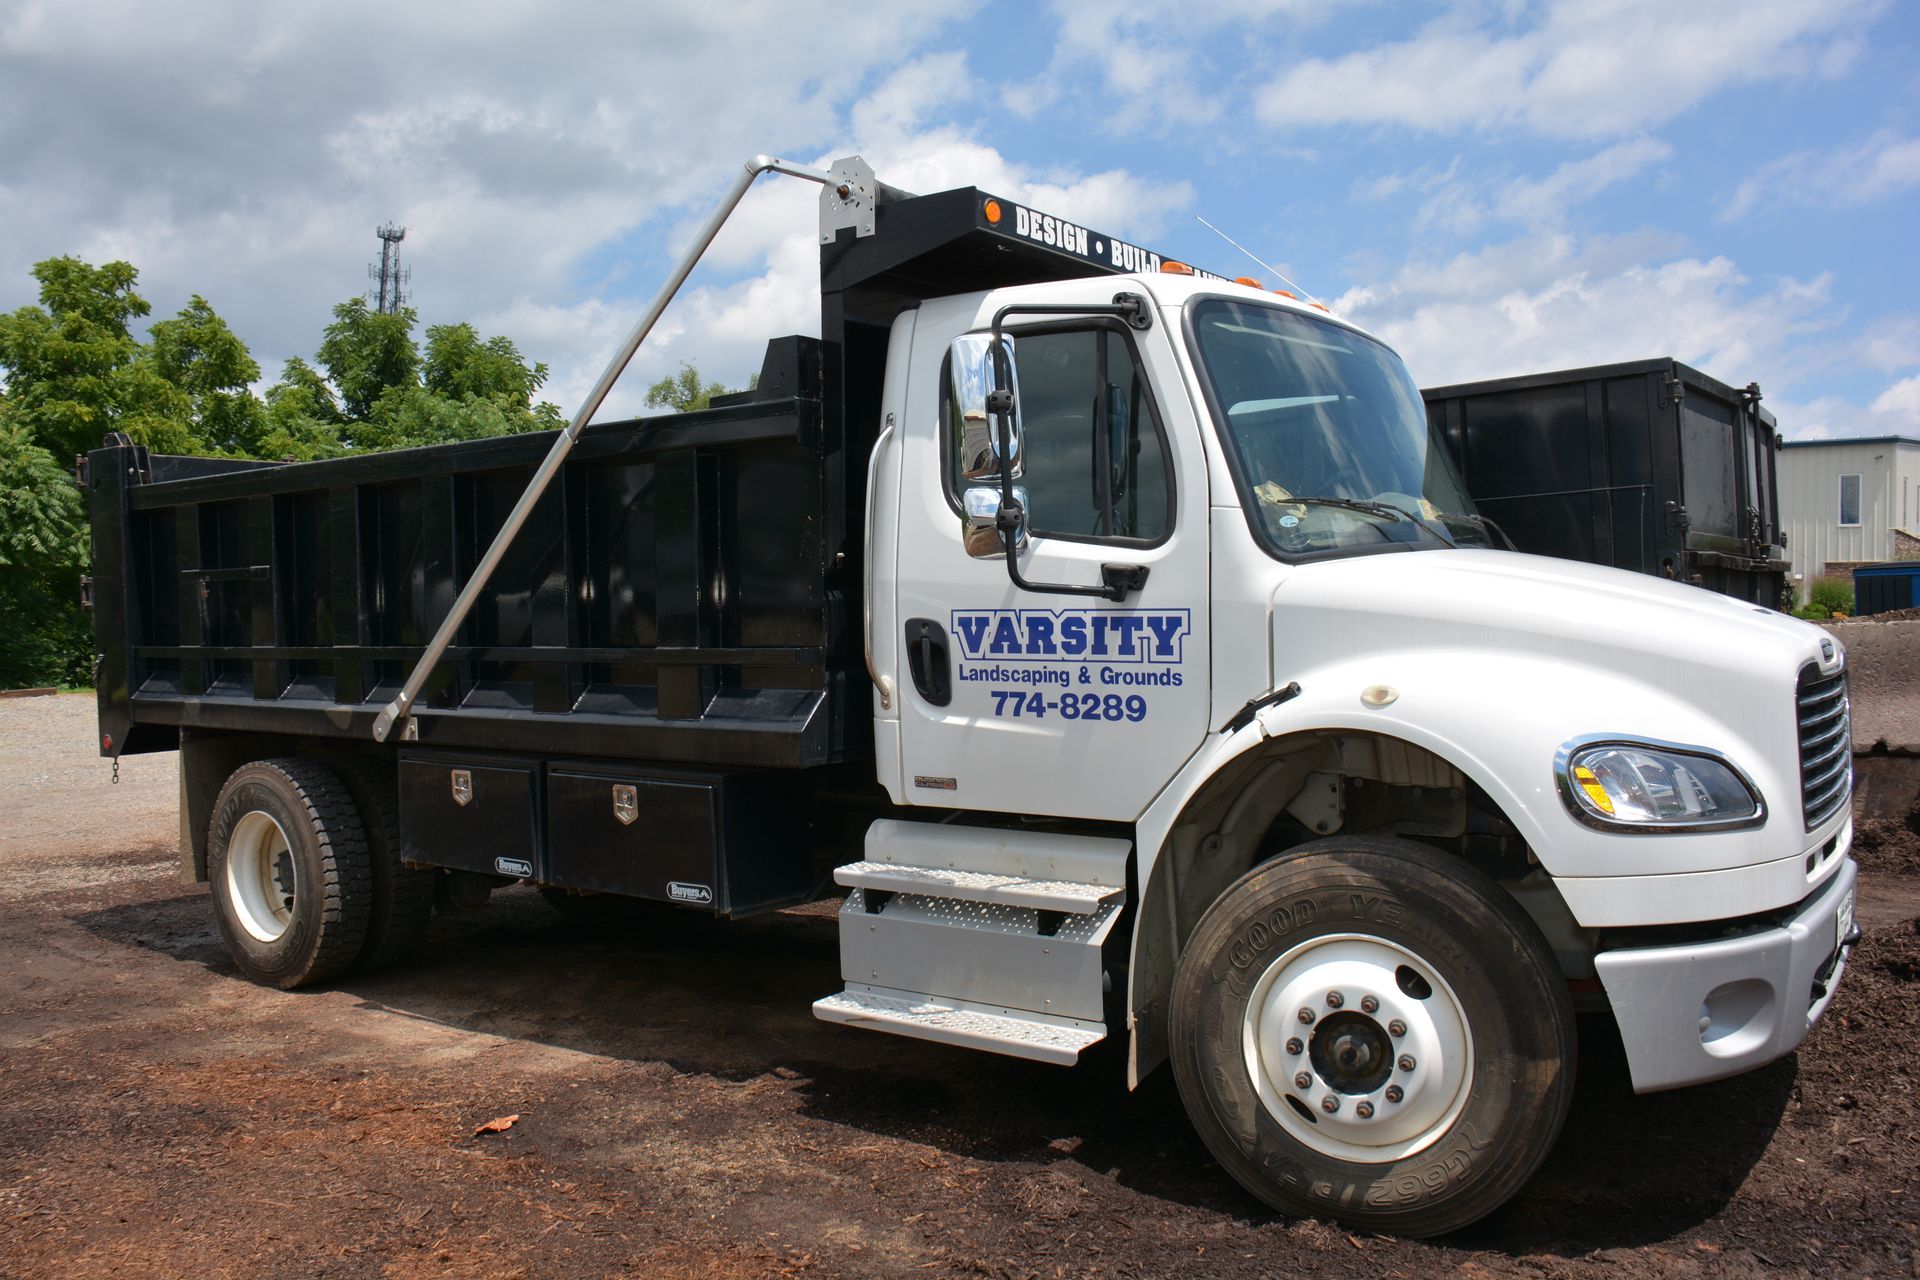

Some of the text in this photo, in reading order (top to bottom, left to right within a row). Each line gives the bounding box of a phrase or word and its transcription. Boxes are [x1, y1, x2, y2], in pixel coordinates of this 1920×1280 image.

[1015, 205, 1161, 274] DESIGN BUILD
[957, 615, 1184, 657] VARSITY
[958, 664, 1183, 687] Landscaping & Grounds
[990, 690, 1148, 723] 774-8289
[671, 883, 700, 898] Buyers
